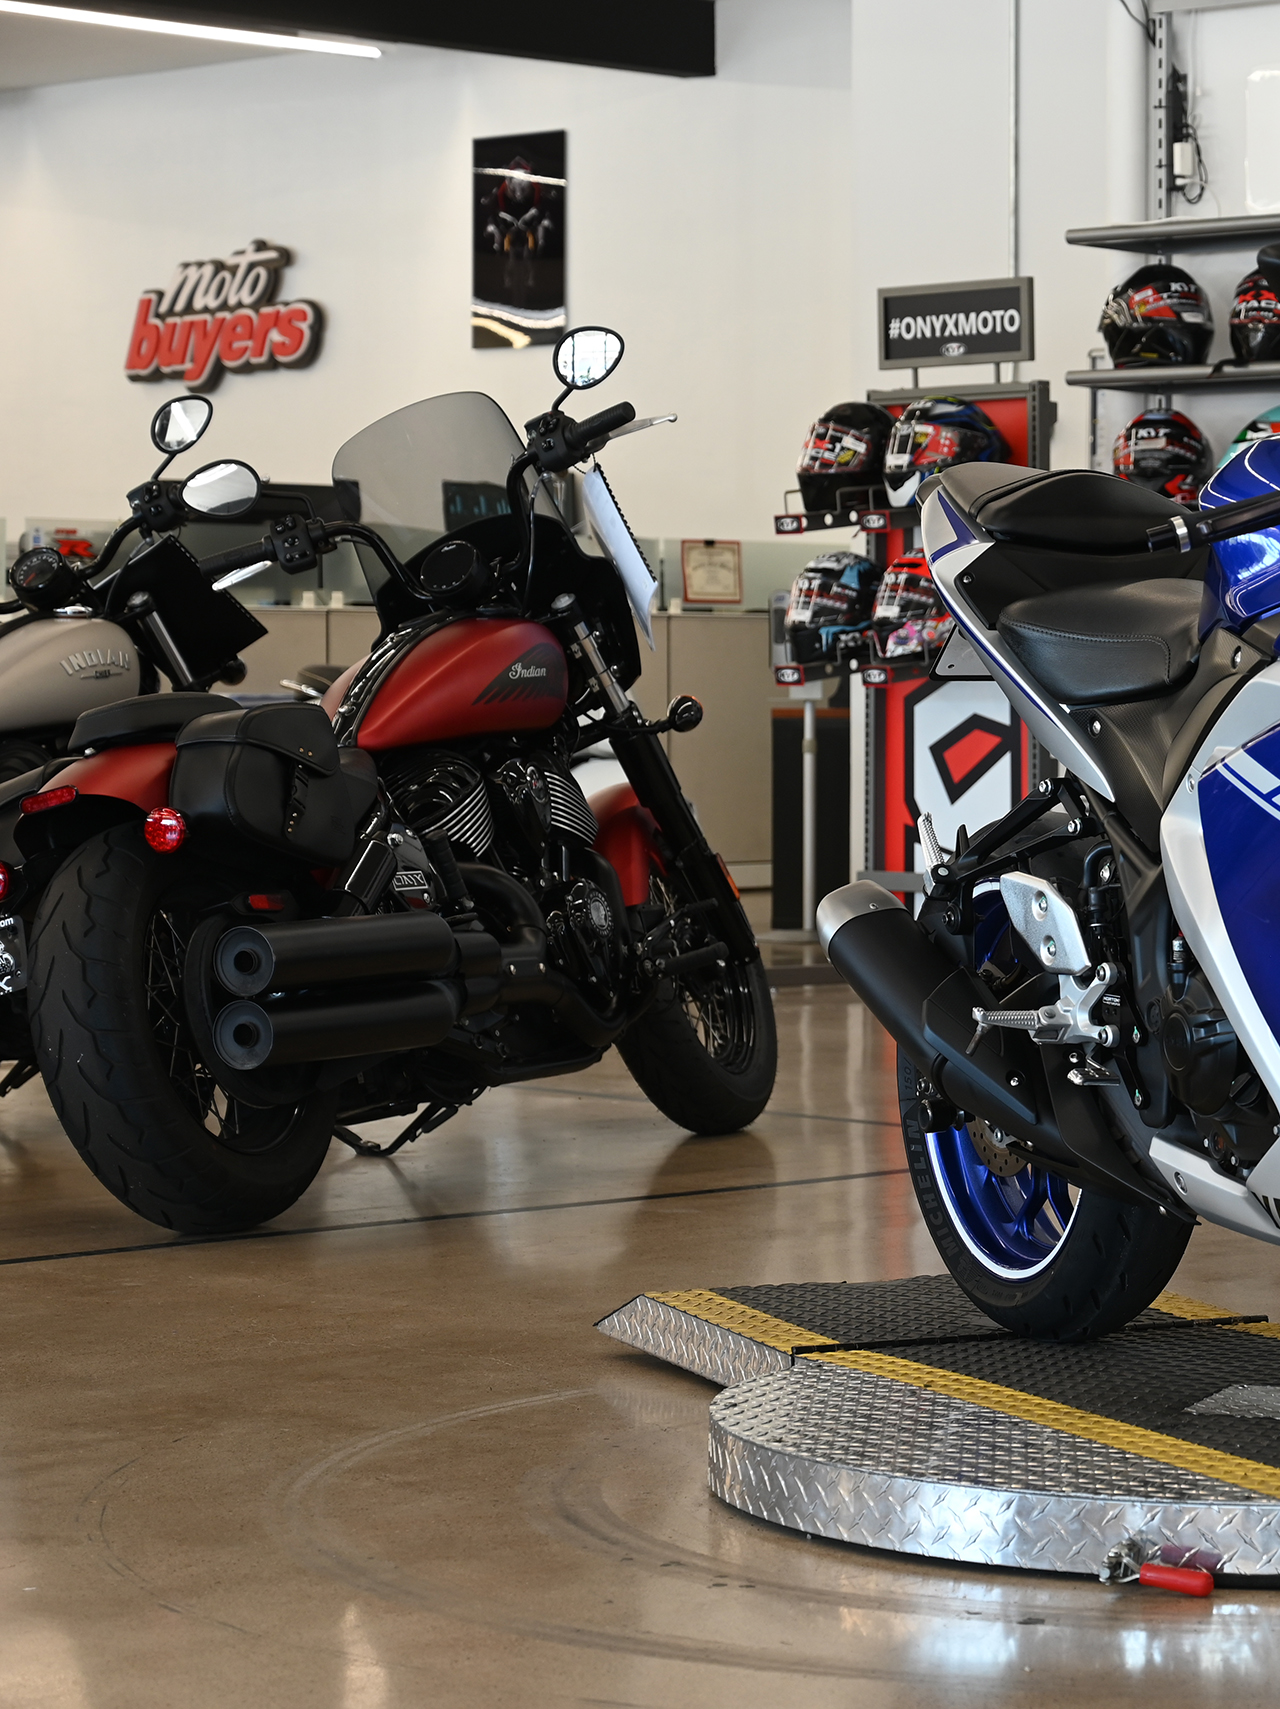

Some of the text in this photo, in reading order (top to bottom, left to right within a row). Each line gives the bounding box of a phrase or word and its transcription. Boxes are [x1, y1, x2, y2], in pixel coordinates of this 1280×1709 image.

[124, 294, 312, 385] buyers
[889, 309, 1021, 341] #ONYXMOTO
[60, 649, 131, 676] INDIAN
[508, 662, 547, 680] Indian
[906, 1119, 959, 1258] MICHELIN
